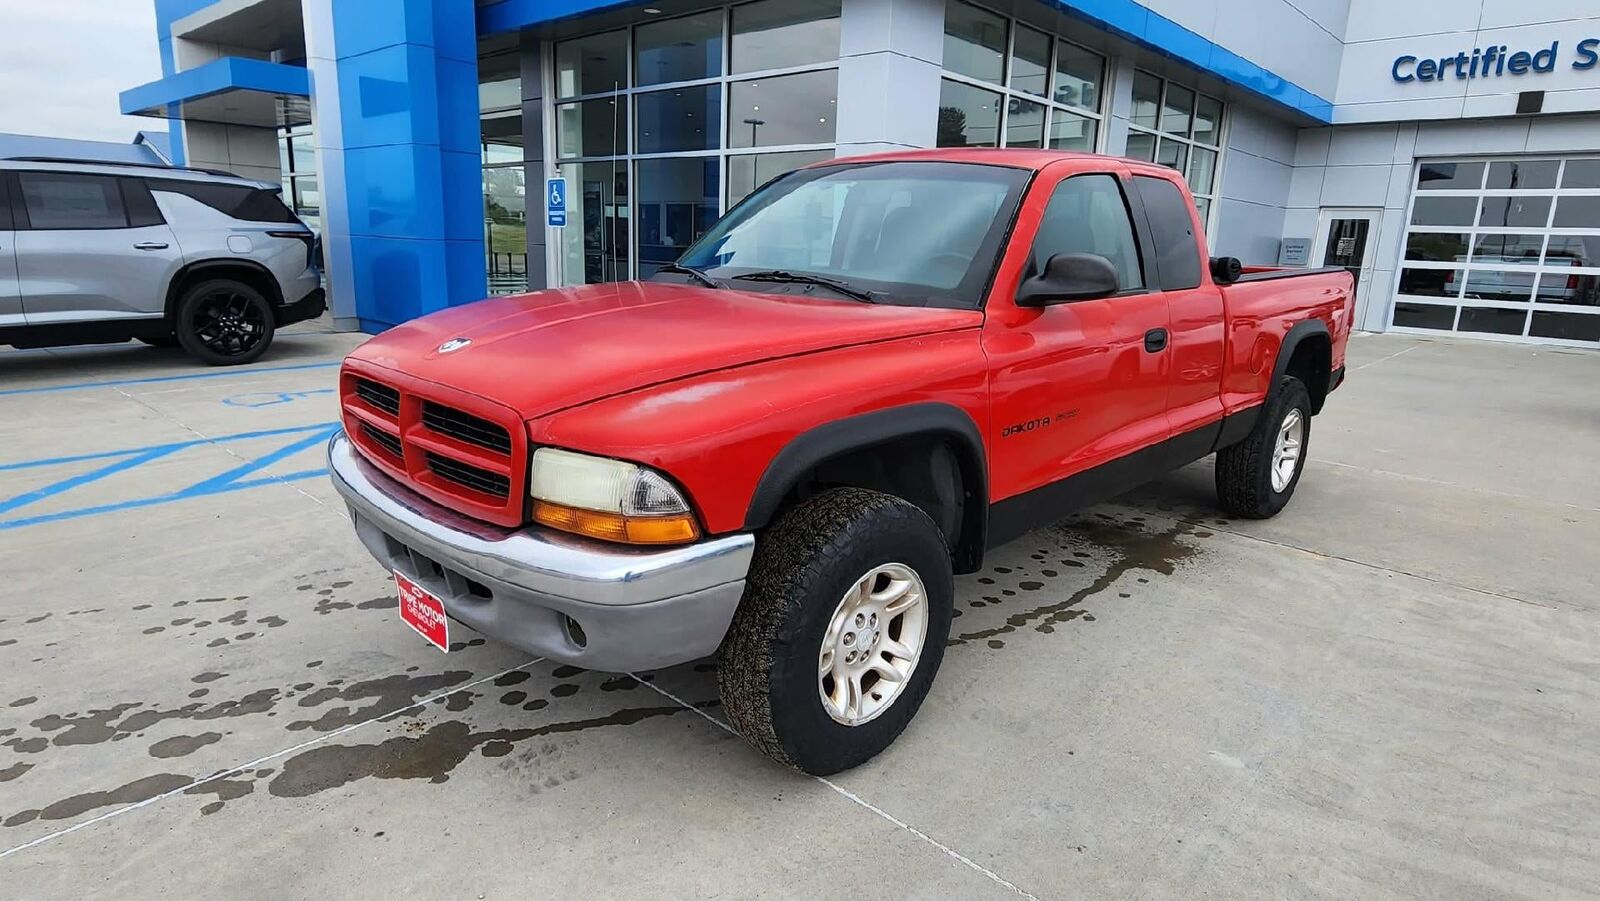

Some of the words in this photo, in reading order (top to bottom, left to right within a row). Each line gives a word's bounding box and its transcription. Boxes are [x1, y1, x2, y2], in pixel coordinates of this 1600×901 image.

[1392, 40, 1559, 83] Certified
[1002, 416, 1051, 438] DAKOTA
[418, 601, 445, 626] MOTOR
